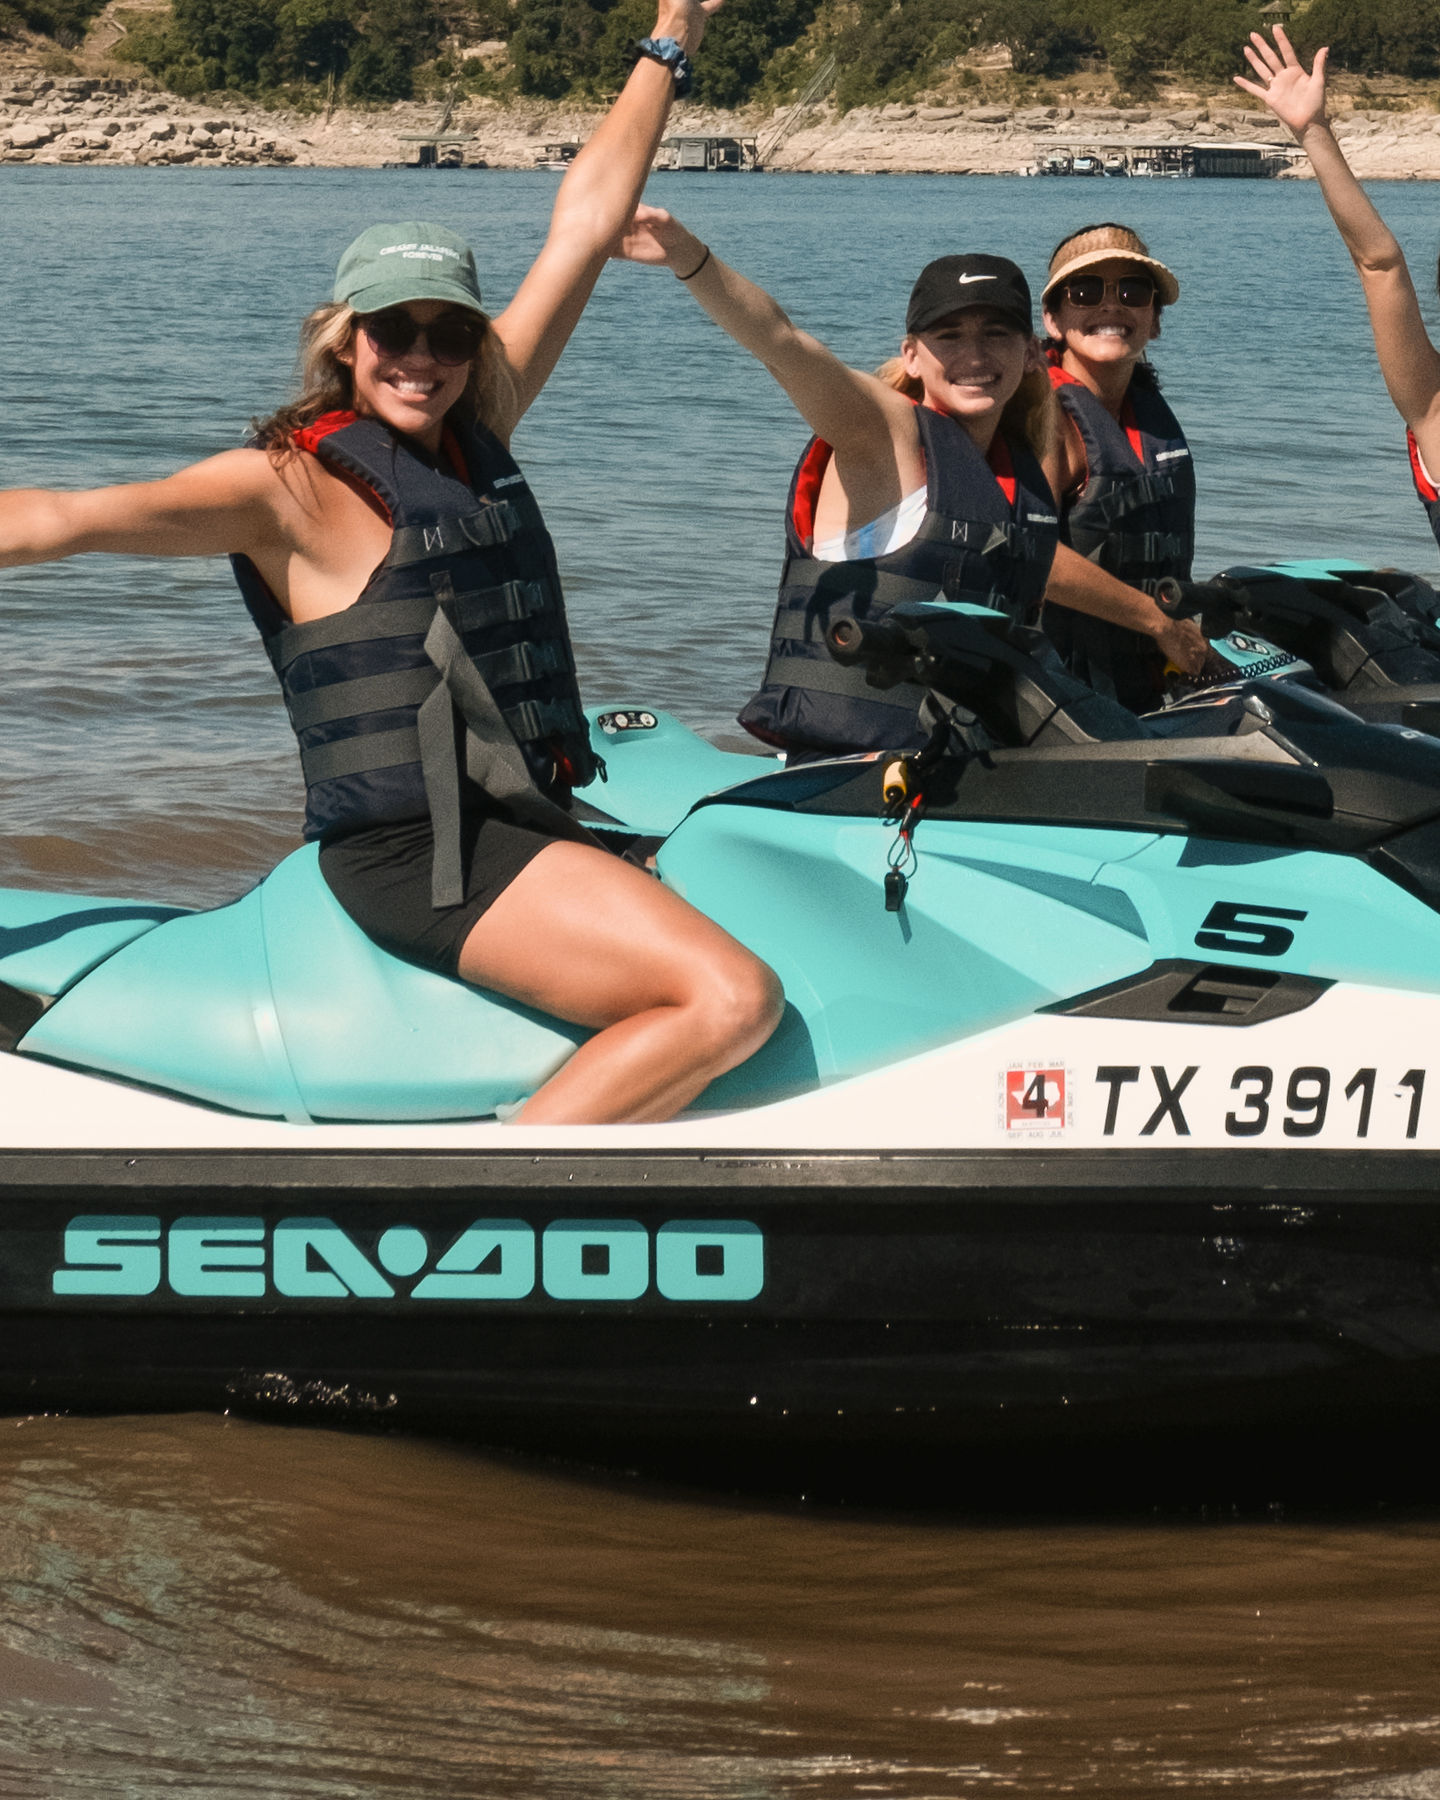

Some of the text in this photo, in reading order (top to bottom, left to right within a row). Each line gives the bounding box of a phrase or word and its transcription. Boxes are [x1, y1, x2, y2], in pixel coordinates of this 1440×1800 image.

[1194, 900, 1308, 957] 5
[1022, 1074, 1049, 1118] 4
[1095, 1065, 1199, 1136] TX
[1224, 1065, 1426, 1139] 3911
